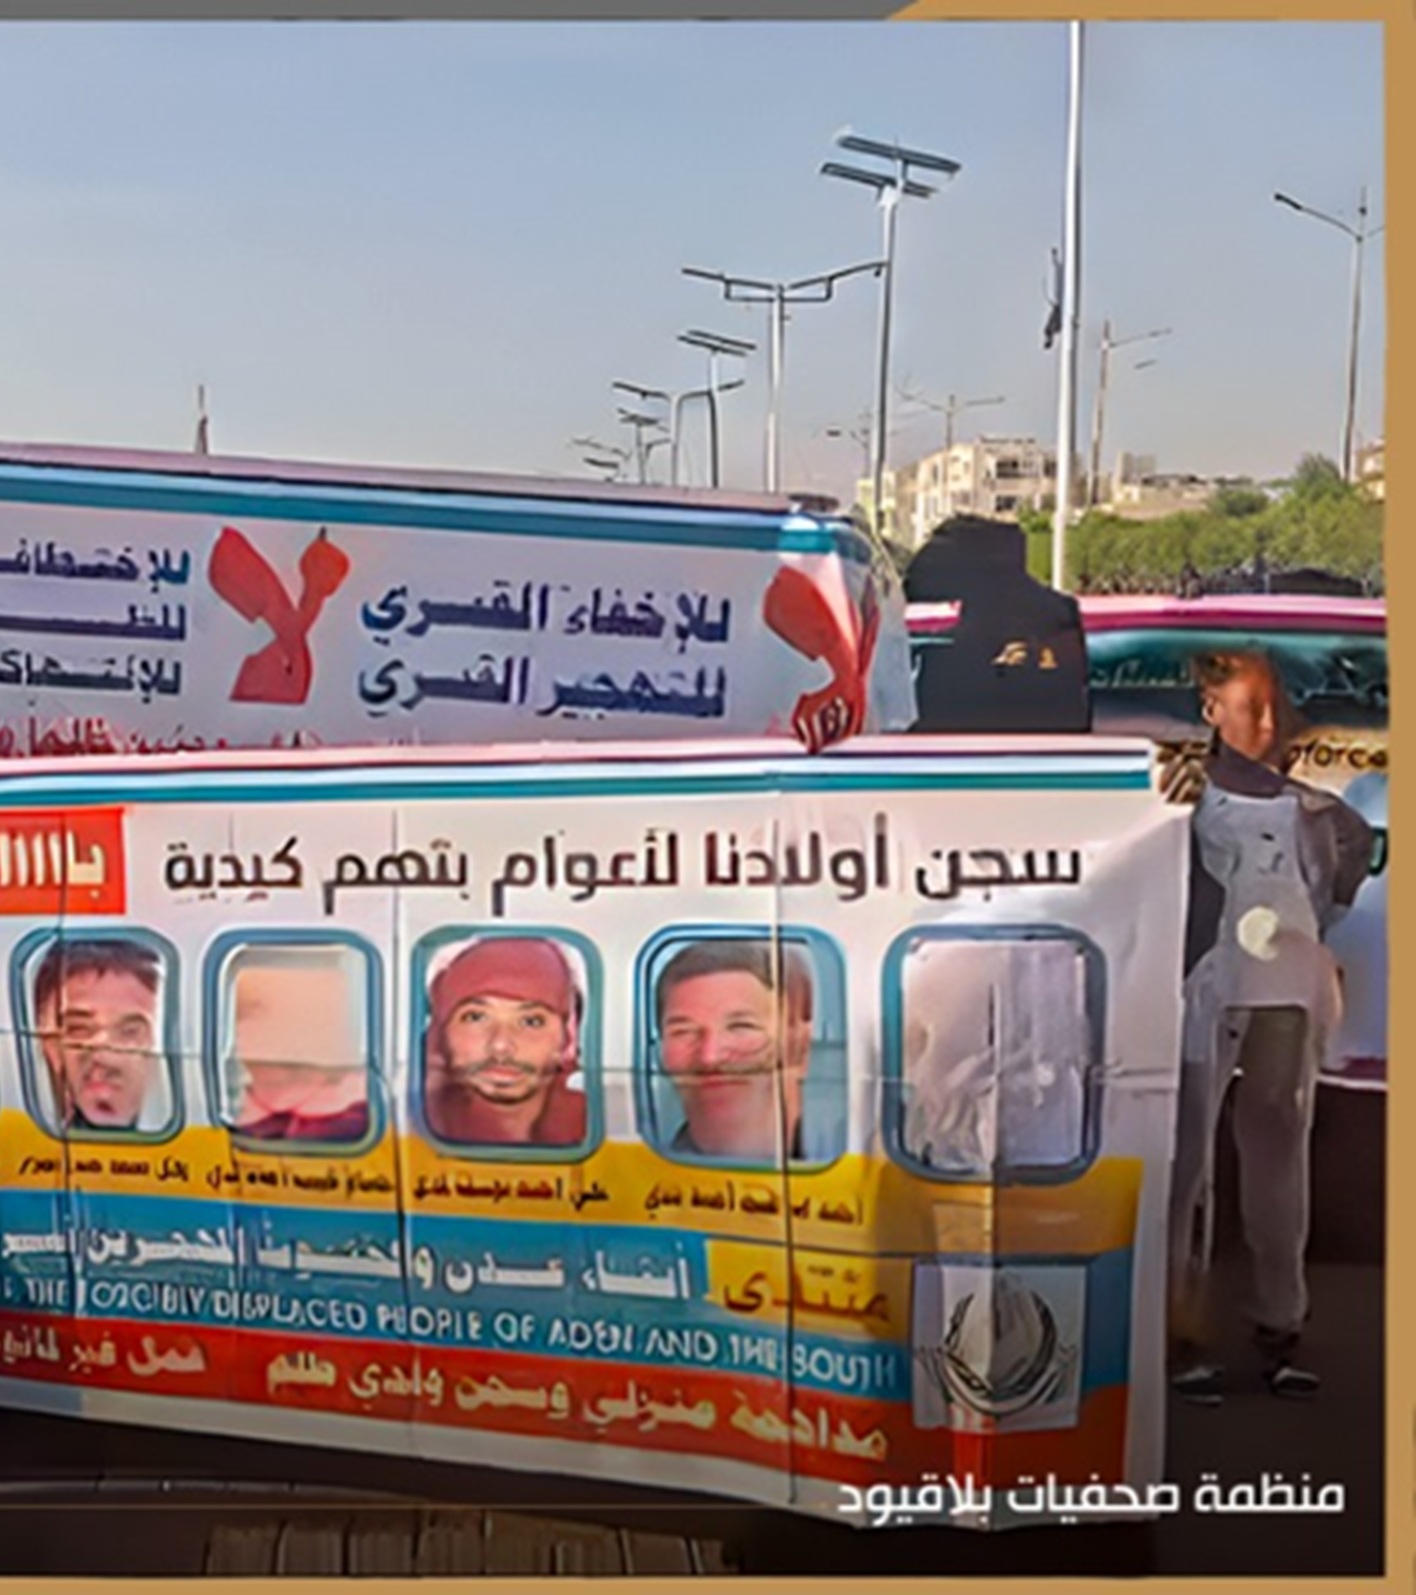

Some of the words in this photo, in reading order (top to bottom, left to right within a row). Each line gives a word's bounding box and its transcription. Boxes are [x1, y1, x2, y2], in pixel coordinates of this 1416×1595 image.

[360, 580, 549, 645] القسري
[358, 654, 530, 718] القسري
[537, 664, 726, 720] للتهجير
[164, 836, 303, 902] كيدية
[323, 838, 469, 916] بتهم
[705, 813, 888, 899] أولادنا
[915, 845, 1082, 903] سجن
[493, 1311, 536, 1343] OF
[643, 1326, 718, 1363] AND
